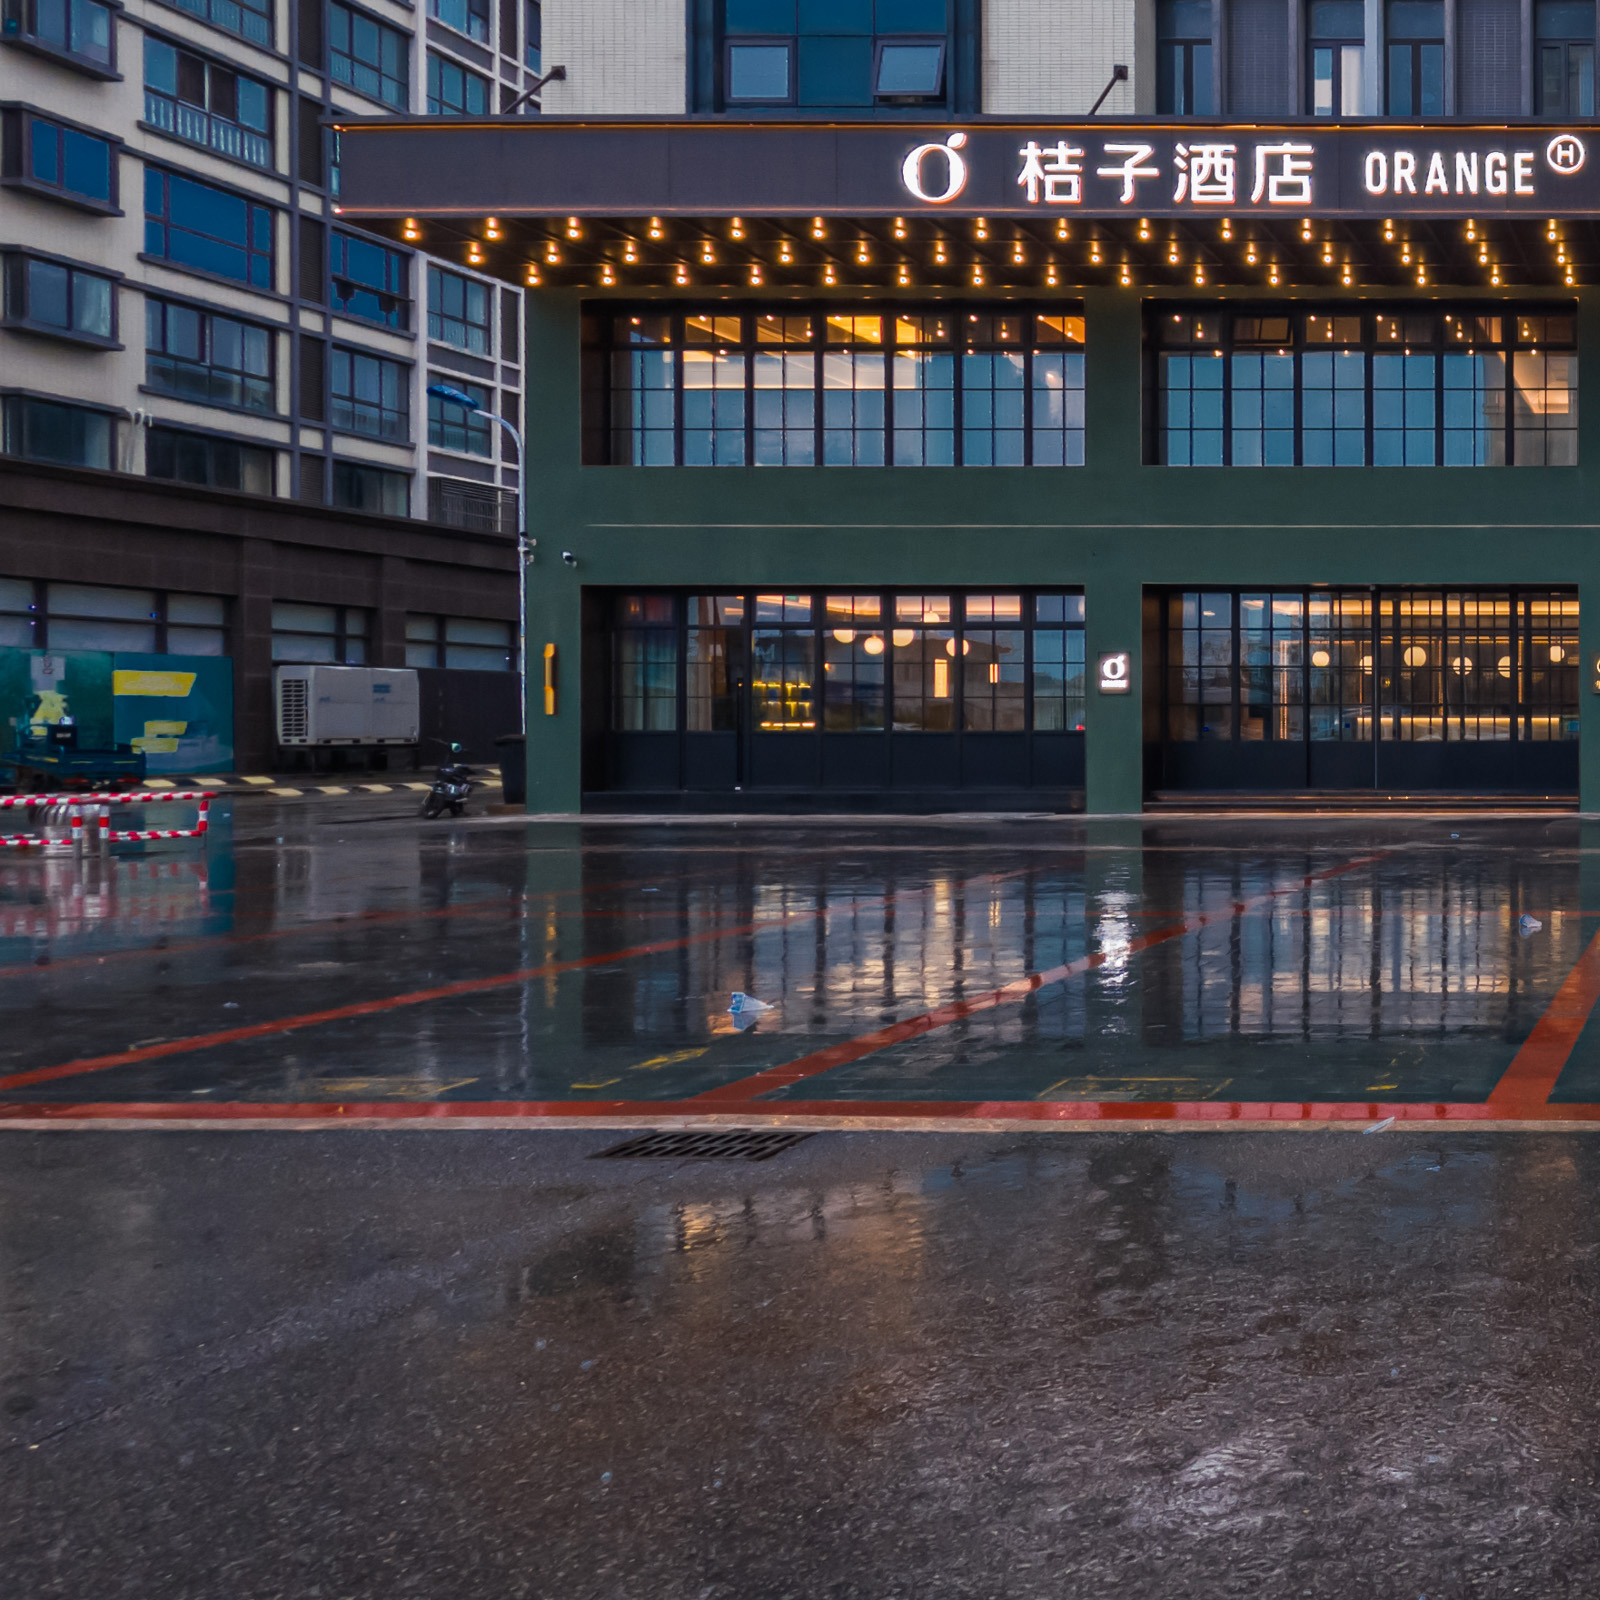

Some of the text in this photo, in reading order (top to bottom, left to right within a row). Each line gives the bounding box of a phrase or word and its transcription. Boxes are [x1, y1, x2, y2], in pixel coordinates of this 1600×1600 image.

[1016, 140, 1313, 204] 桔子酒店
[1364, 150, 1536, 196] ORANGE
